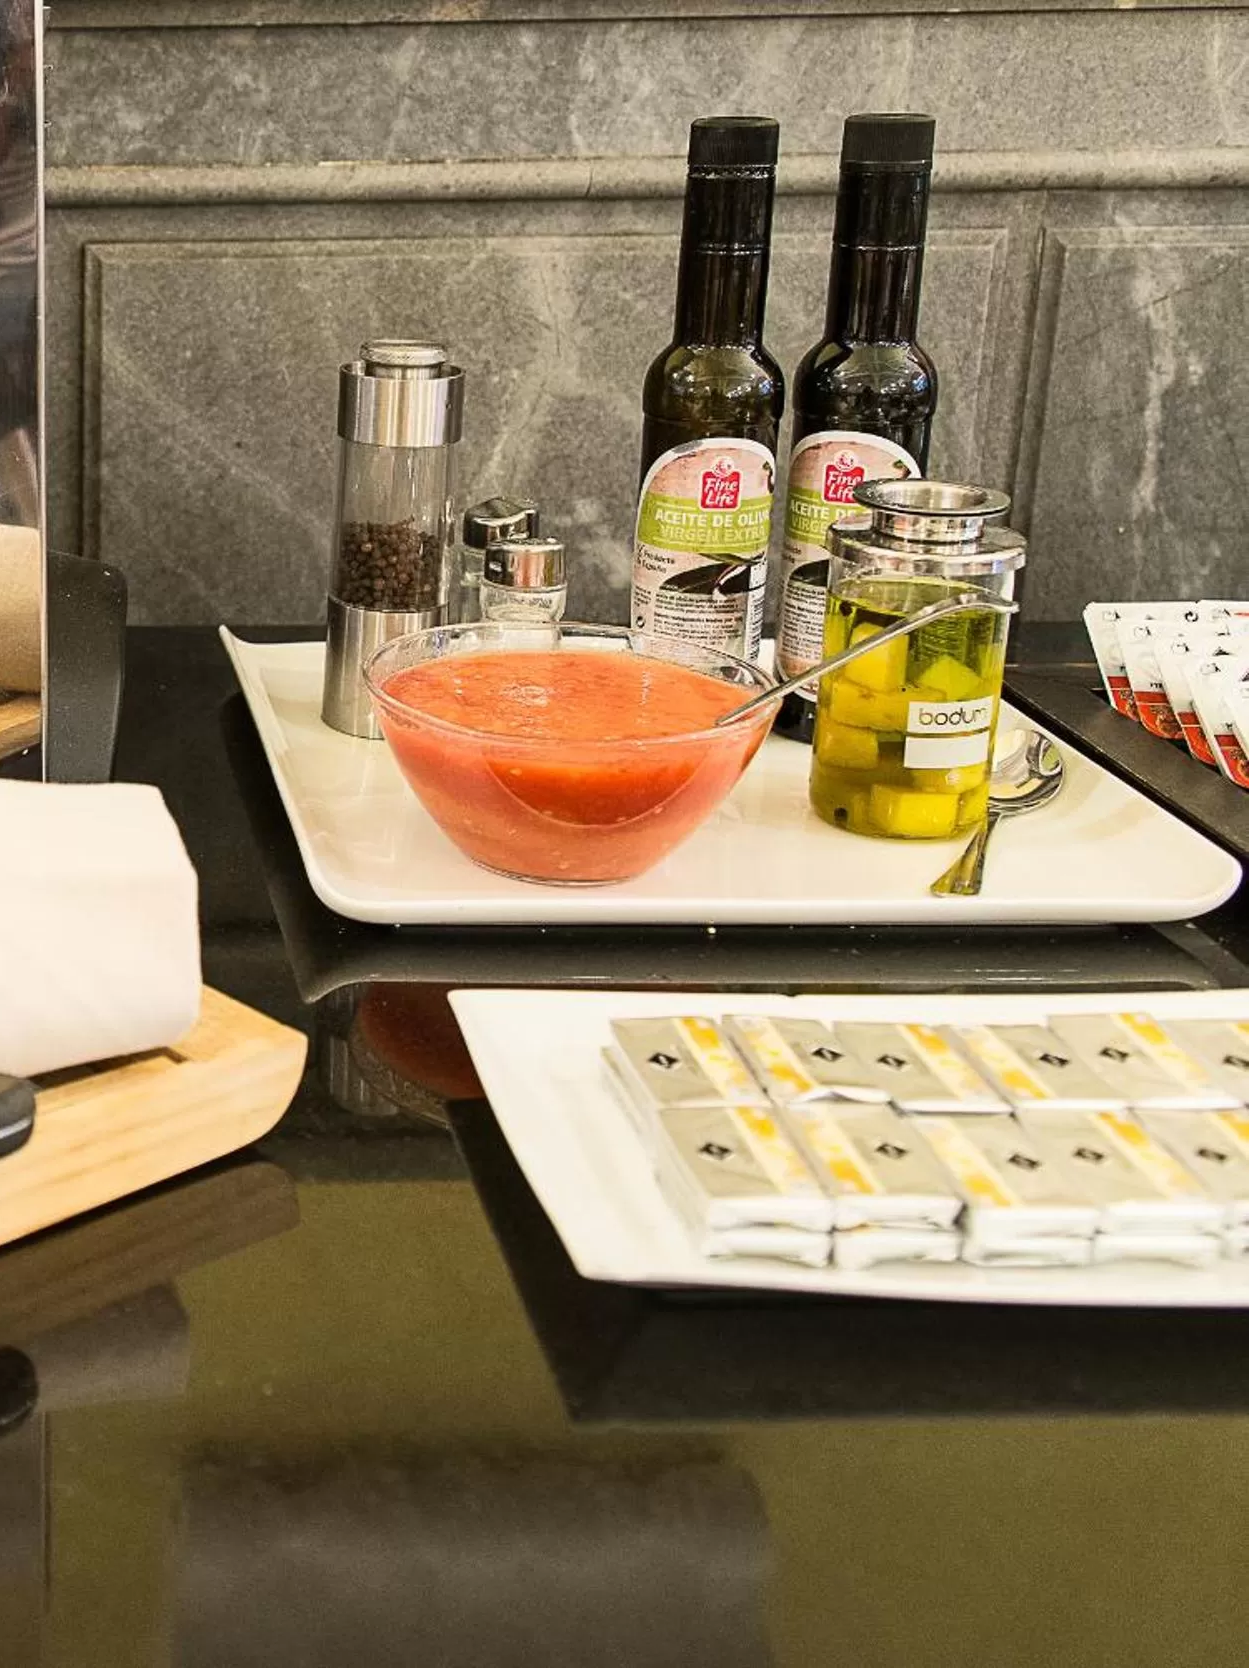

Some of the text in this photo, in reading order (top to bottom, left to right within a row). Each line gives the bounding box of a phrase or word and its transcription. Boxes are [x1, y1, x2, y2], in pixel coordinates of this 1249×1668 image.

[704, 477, 739, 493] Fine
[828, 471, 862, 487] Fine
[705, 489, 736, 505] Life
[654, 507, 708, 528] ACEITE
[711, 513, 734, 528] DE
[658, 522, 719, 542] VIRGEN
